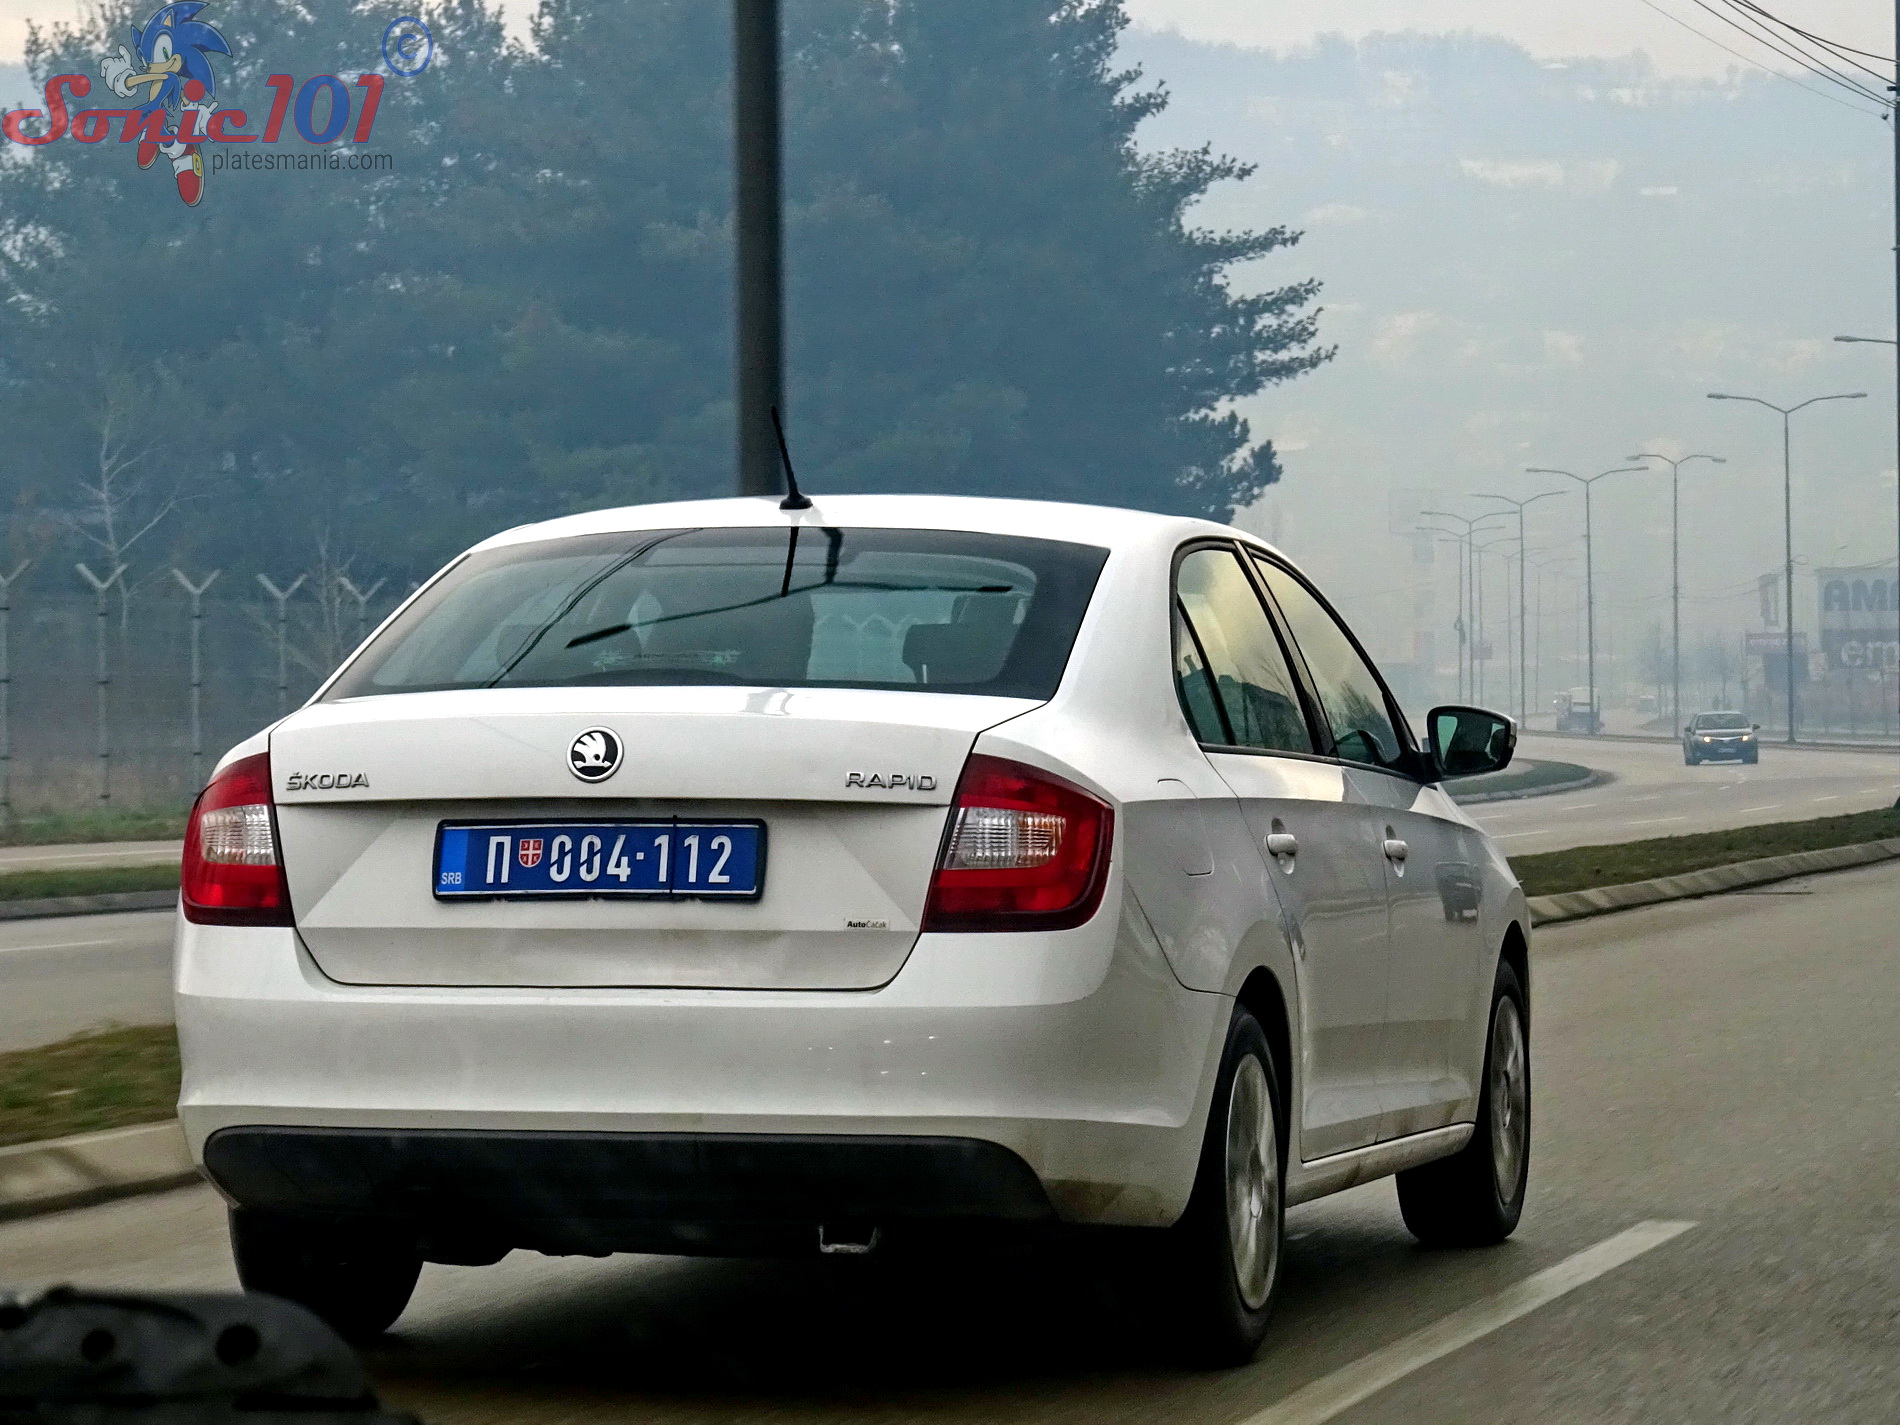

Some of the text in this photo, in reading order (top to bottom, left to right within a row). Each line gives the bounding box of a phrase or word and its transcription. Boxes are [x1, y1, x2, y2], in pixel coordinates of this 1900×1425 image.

[286, 771, 370, 791] ŠKODA
[845, 771, 937, 791] RAPID
[441, 872, 462, 885] SRB
